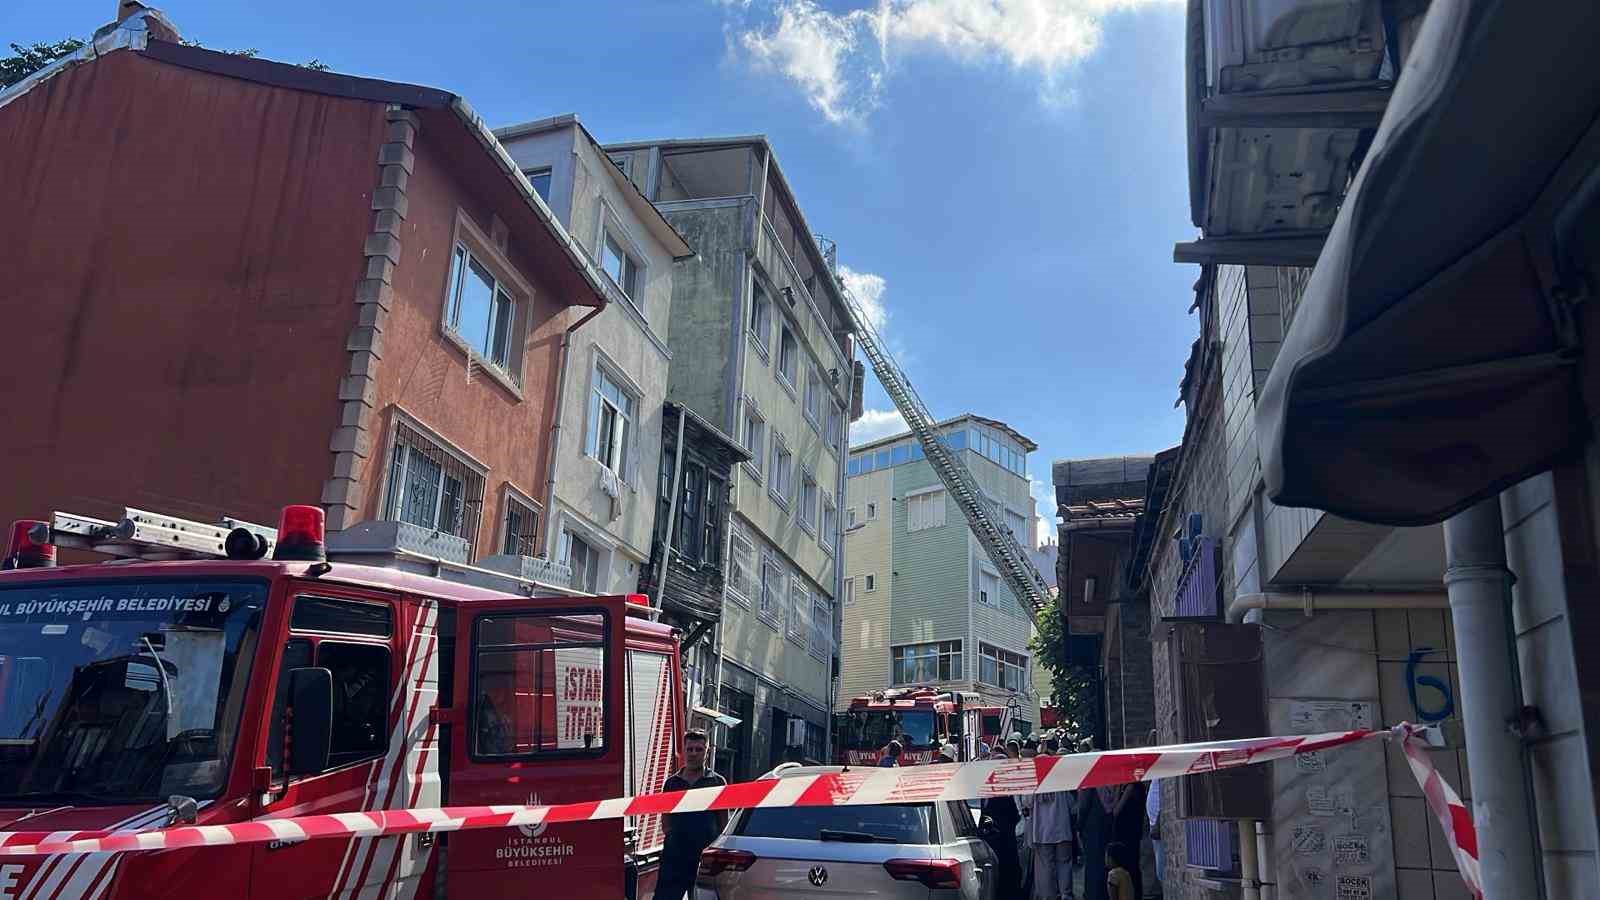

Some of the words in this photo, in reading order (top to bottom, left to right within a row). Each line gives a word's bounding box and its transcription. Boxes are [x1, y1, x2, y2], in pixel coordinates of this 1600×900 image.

[16, 595, 113, 616] BÜYÜKŞEHİR
[116, 595, 213, 612] BELEDİYESİ
[508, 836, 562, 845] İSTANBUL
[508, 857, 563, 867] BELEDİYESİ
